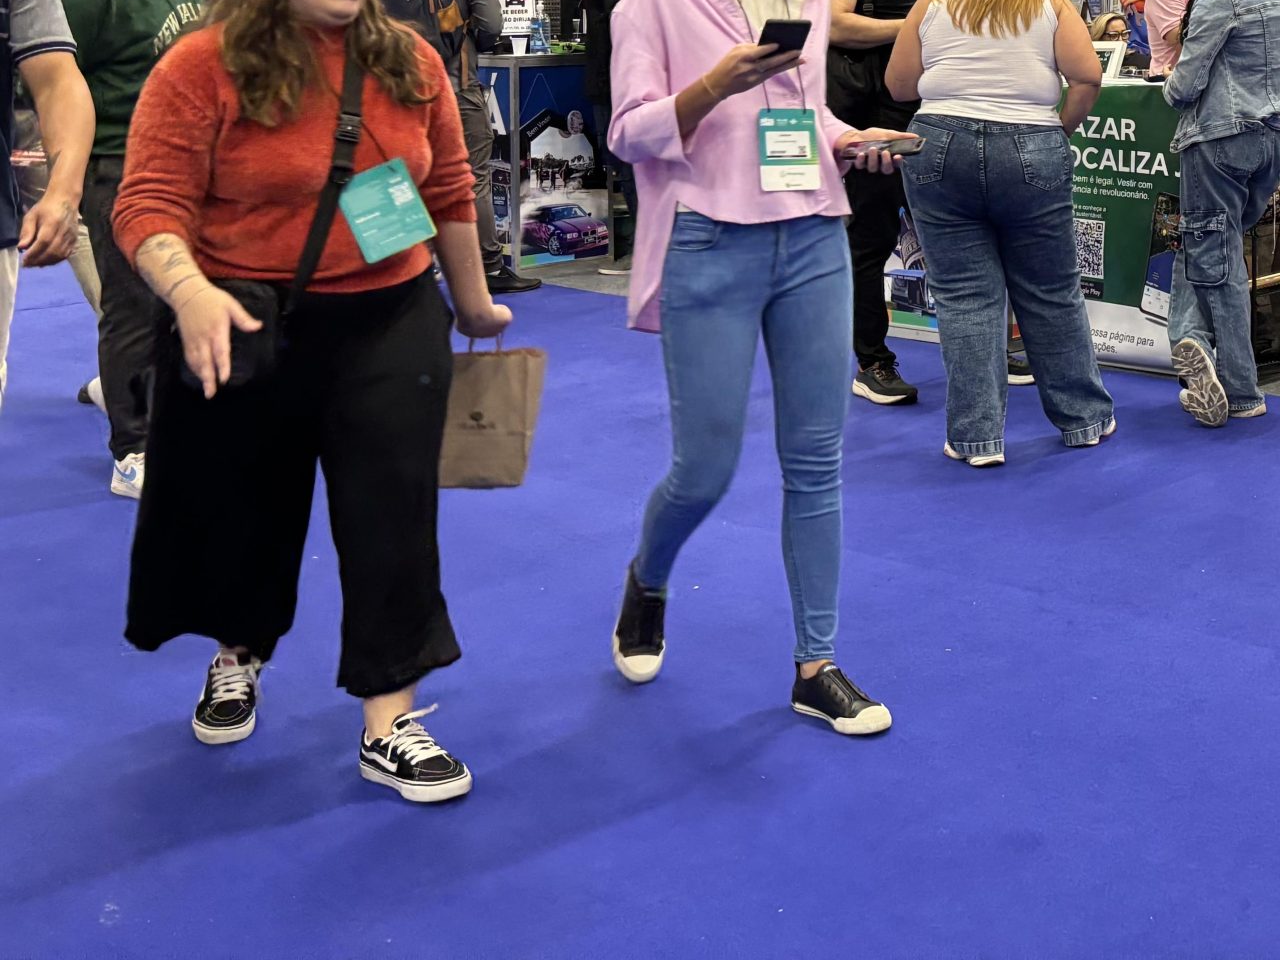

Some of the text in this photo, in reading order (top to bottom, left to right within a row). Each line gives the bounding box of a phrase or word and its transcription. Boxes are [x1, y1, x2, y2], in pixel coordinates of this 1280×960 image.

[154, 11, 181, 56] NEW
[1070, 145, 1169, 177] OCALIZA
[1117, 177, 1136, 188] Vestir
[1138, 181, 1153, 190] com
[1090, 328, 1155, 347] ossa página para
[1093, 342, 1118, 354] ações.
